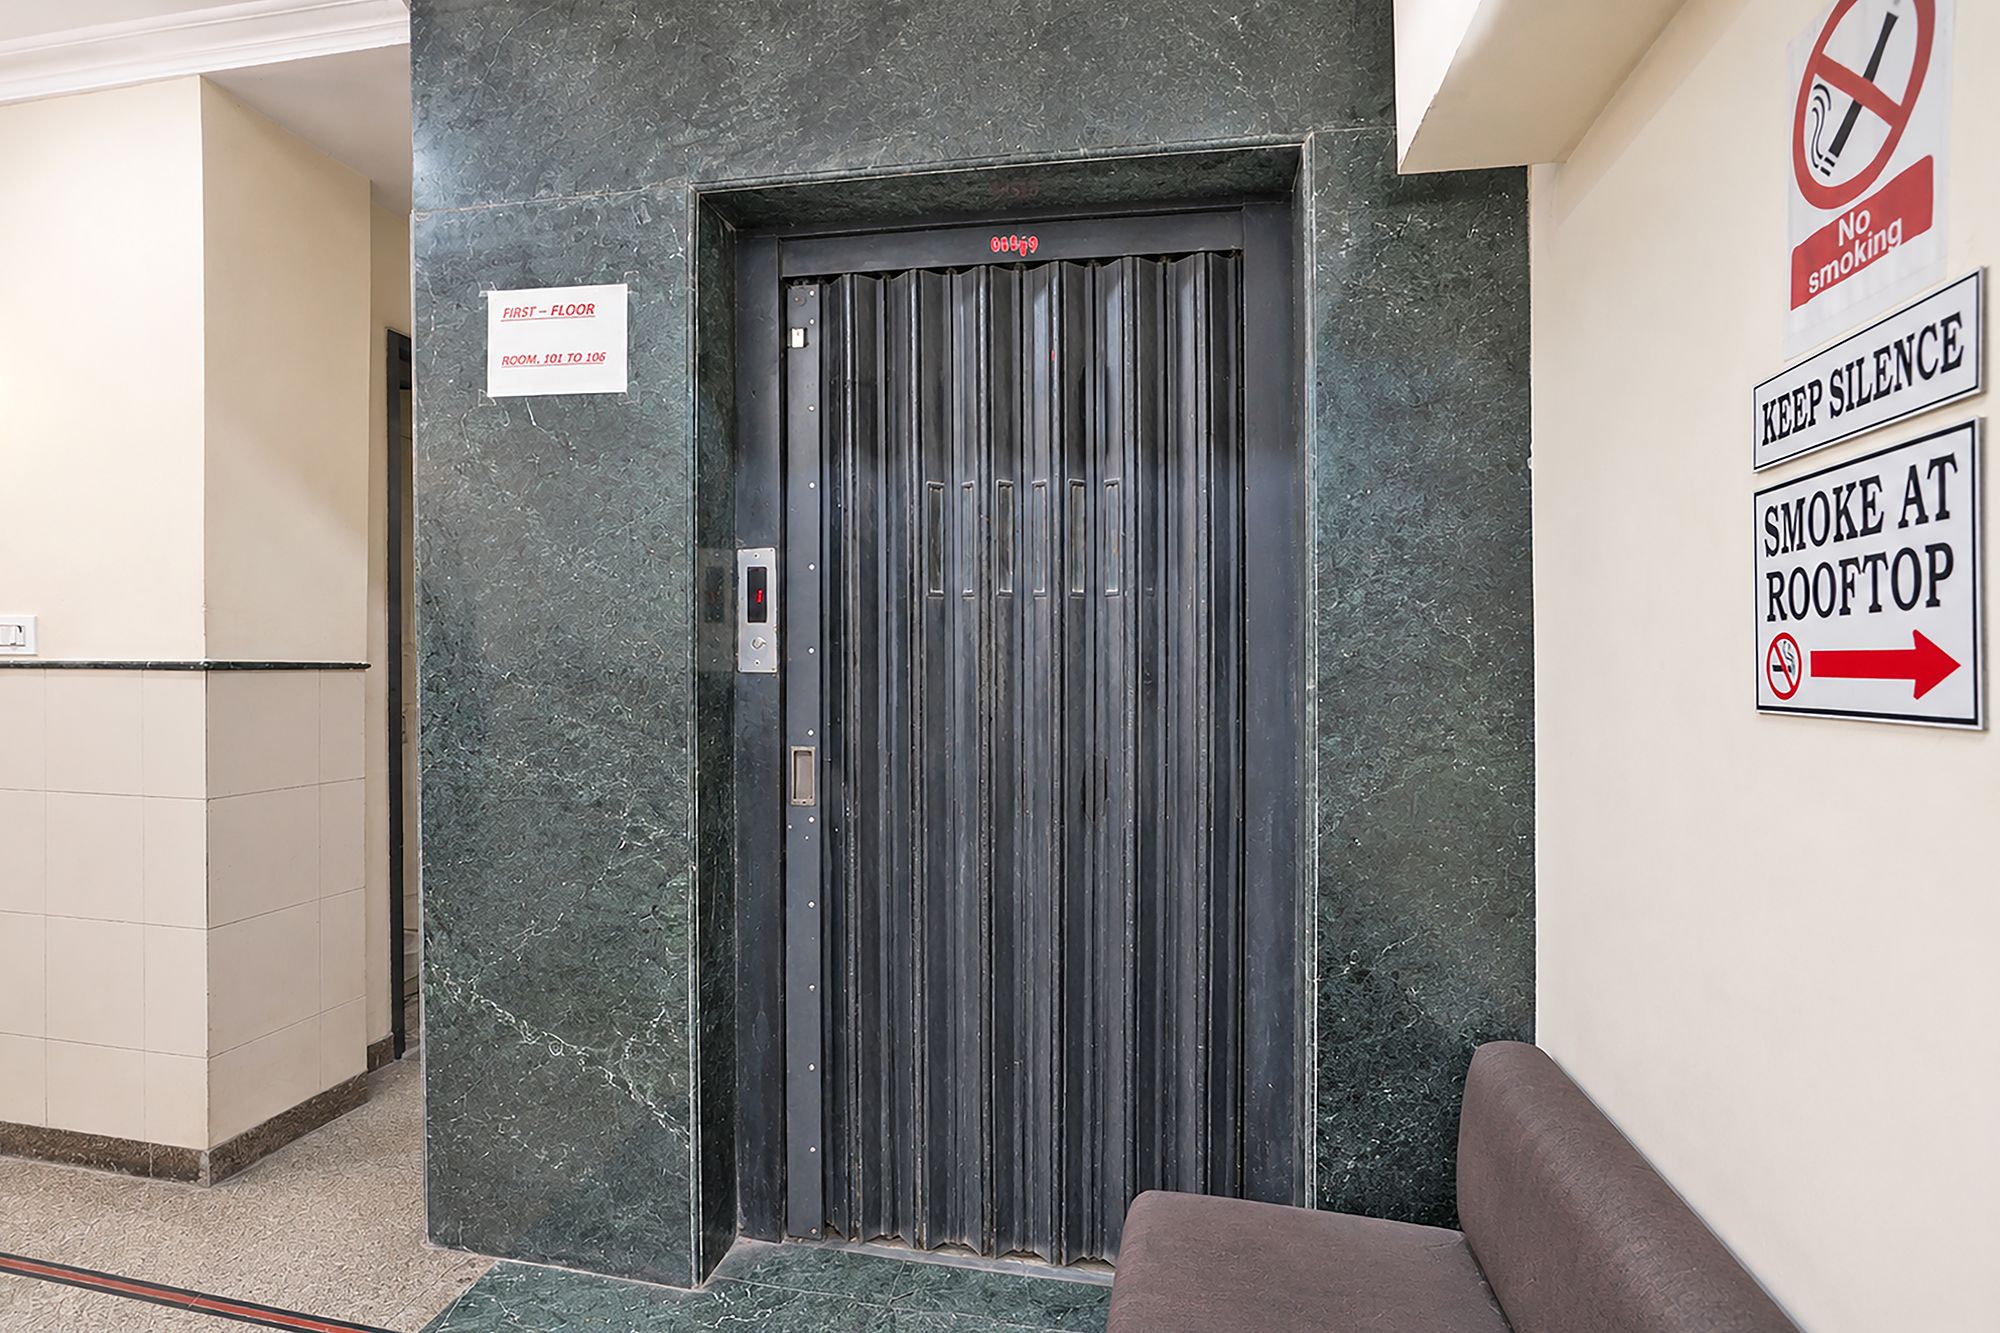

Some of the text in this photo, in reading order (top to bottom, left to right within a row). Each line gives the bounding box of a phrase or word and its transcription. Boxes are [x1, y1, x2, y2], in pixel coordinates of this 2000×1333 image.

[1808, 218, 1902, 294] smoking
[1838, 209, 1871, 247] No
[502, 306, 537, 319] FIRST
[550, 303, 595, 316] FLOOR
[501, 352, 606, 366] ROOM. 101 TO 106
[1761, 311, 1964, 446] KEEP SILENCE
[1764, 452, 1958, 558] SMOKE AT
[1766, 542, 1954, 622] ROOFTOP
